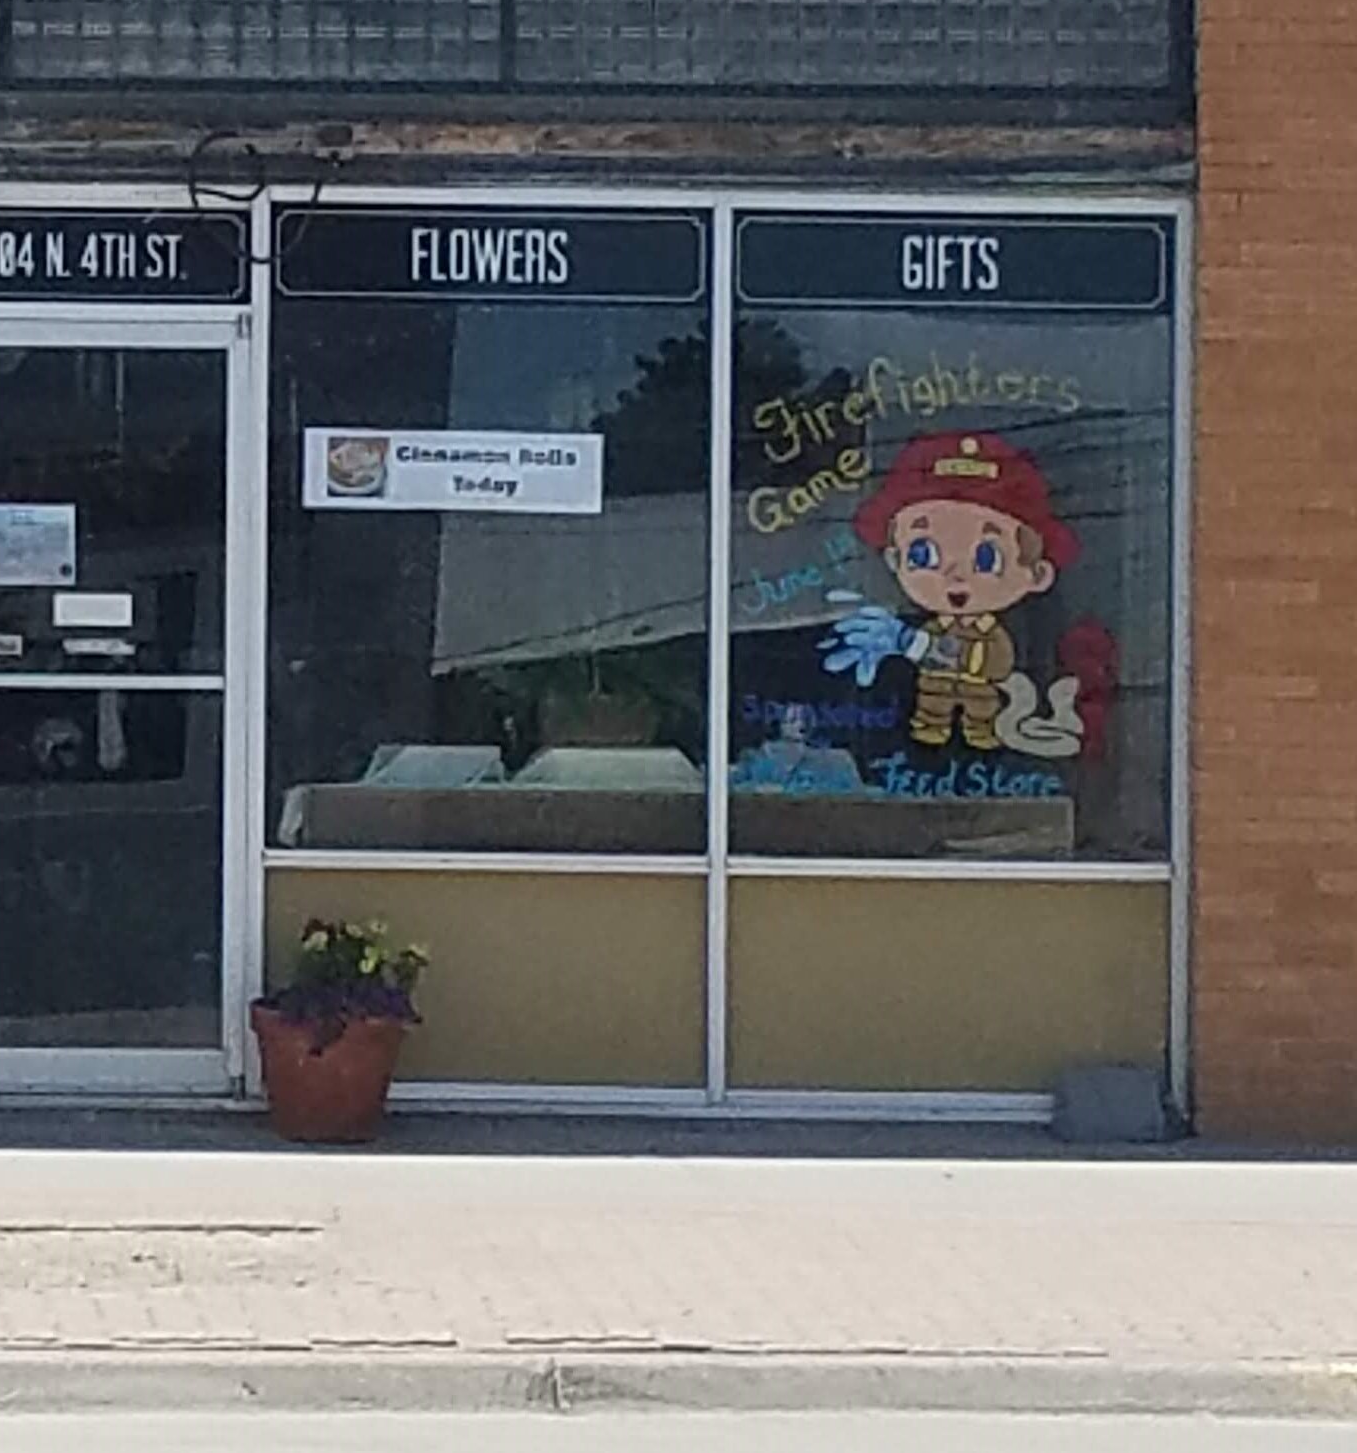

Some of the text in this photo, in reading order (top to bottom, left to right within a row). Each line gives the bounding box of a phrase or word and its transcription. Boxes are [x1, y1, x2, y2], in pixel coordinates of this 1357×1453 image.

[80, 232, 136, 279] 4TH
[146, 233, 189, 280] ST.
[412, 227, 568, 284] FLOWERS
[902, 234, 1000, 290] GIFTS
[747, 447, 872, 534] Game
